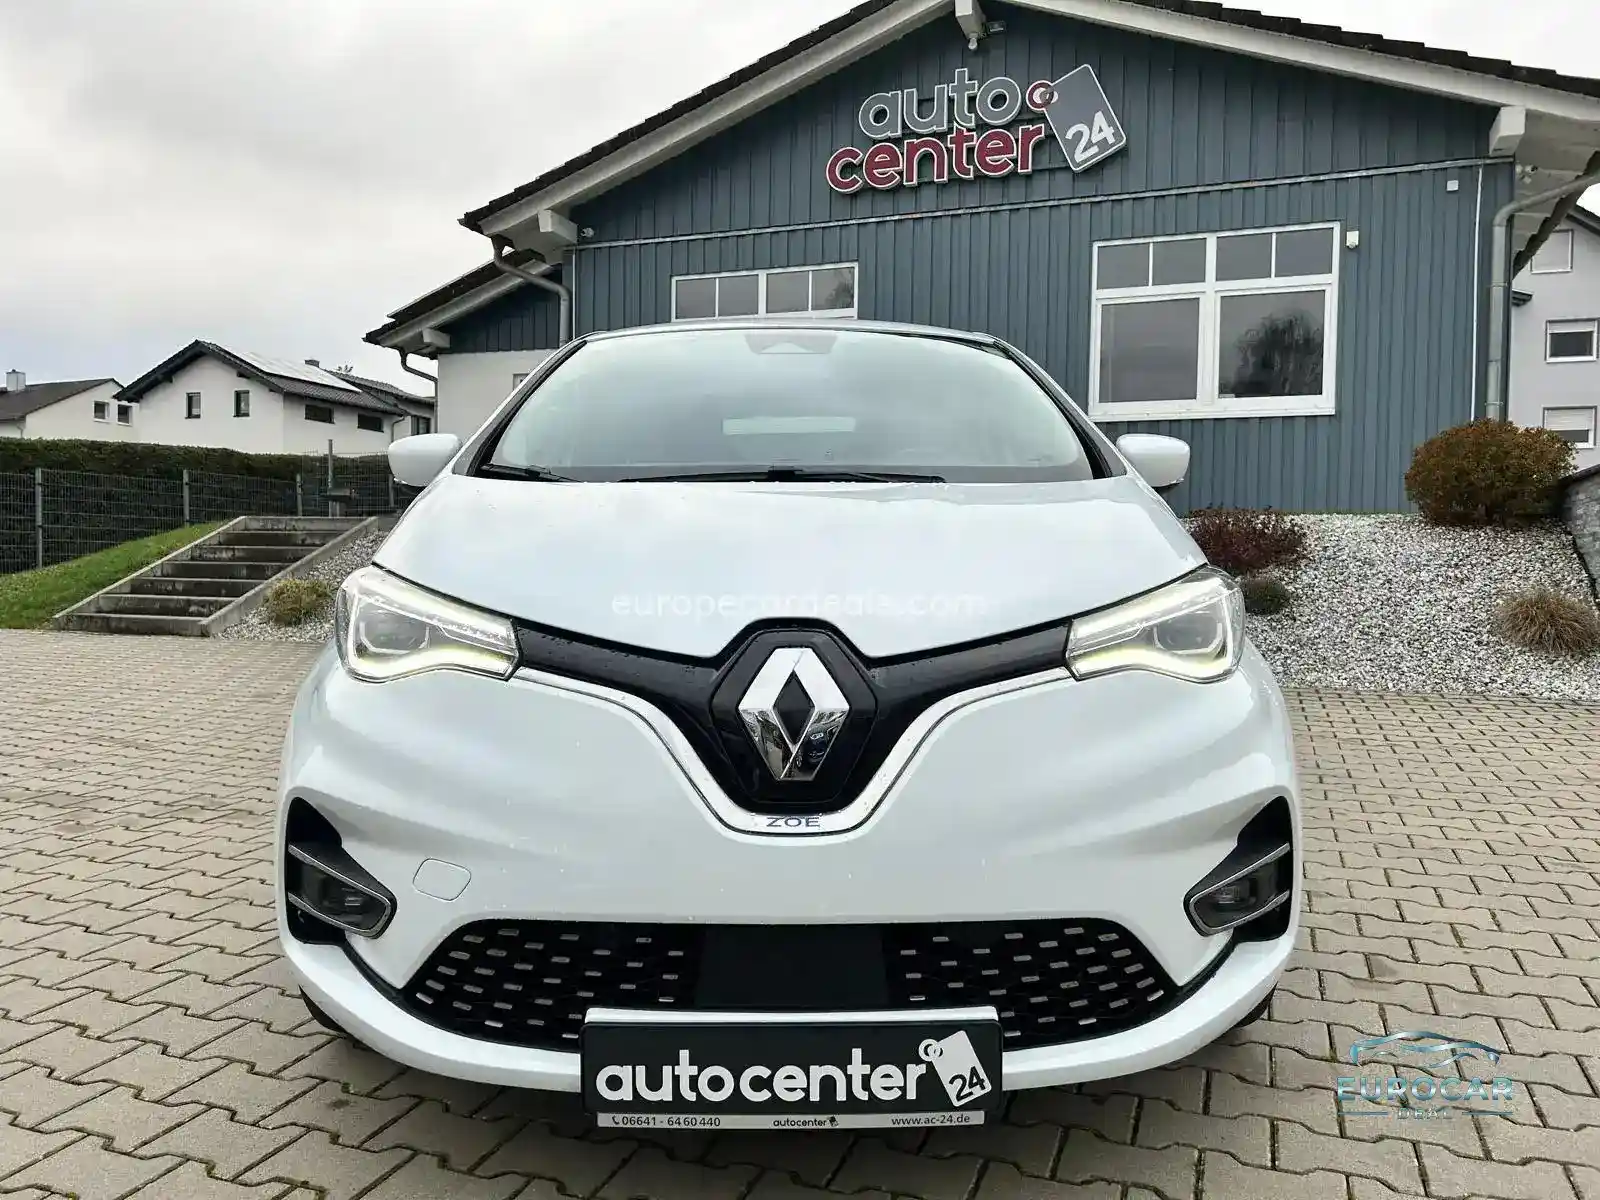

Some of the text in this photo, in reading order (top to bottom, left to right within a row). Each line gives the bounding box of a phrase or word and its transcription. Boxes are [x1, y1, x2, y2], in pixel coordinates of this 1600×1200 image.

[858, 67, 1022, 139] auto
[825, 119, 1045, 194] center
[1065, 110, 1115, 163] 24
[596, 1048, 986, 1102] autocenter 24
[621, 1116, 656, 1126] 06641
[773, 1117, 827, 1127] autocenter
[891, 1113, 971, 1126] www.ac-24.de
